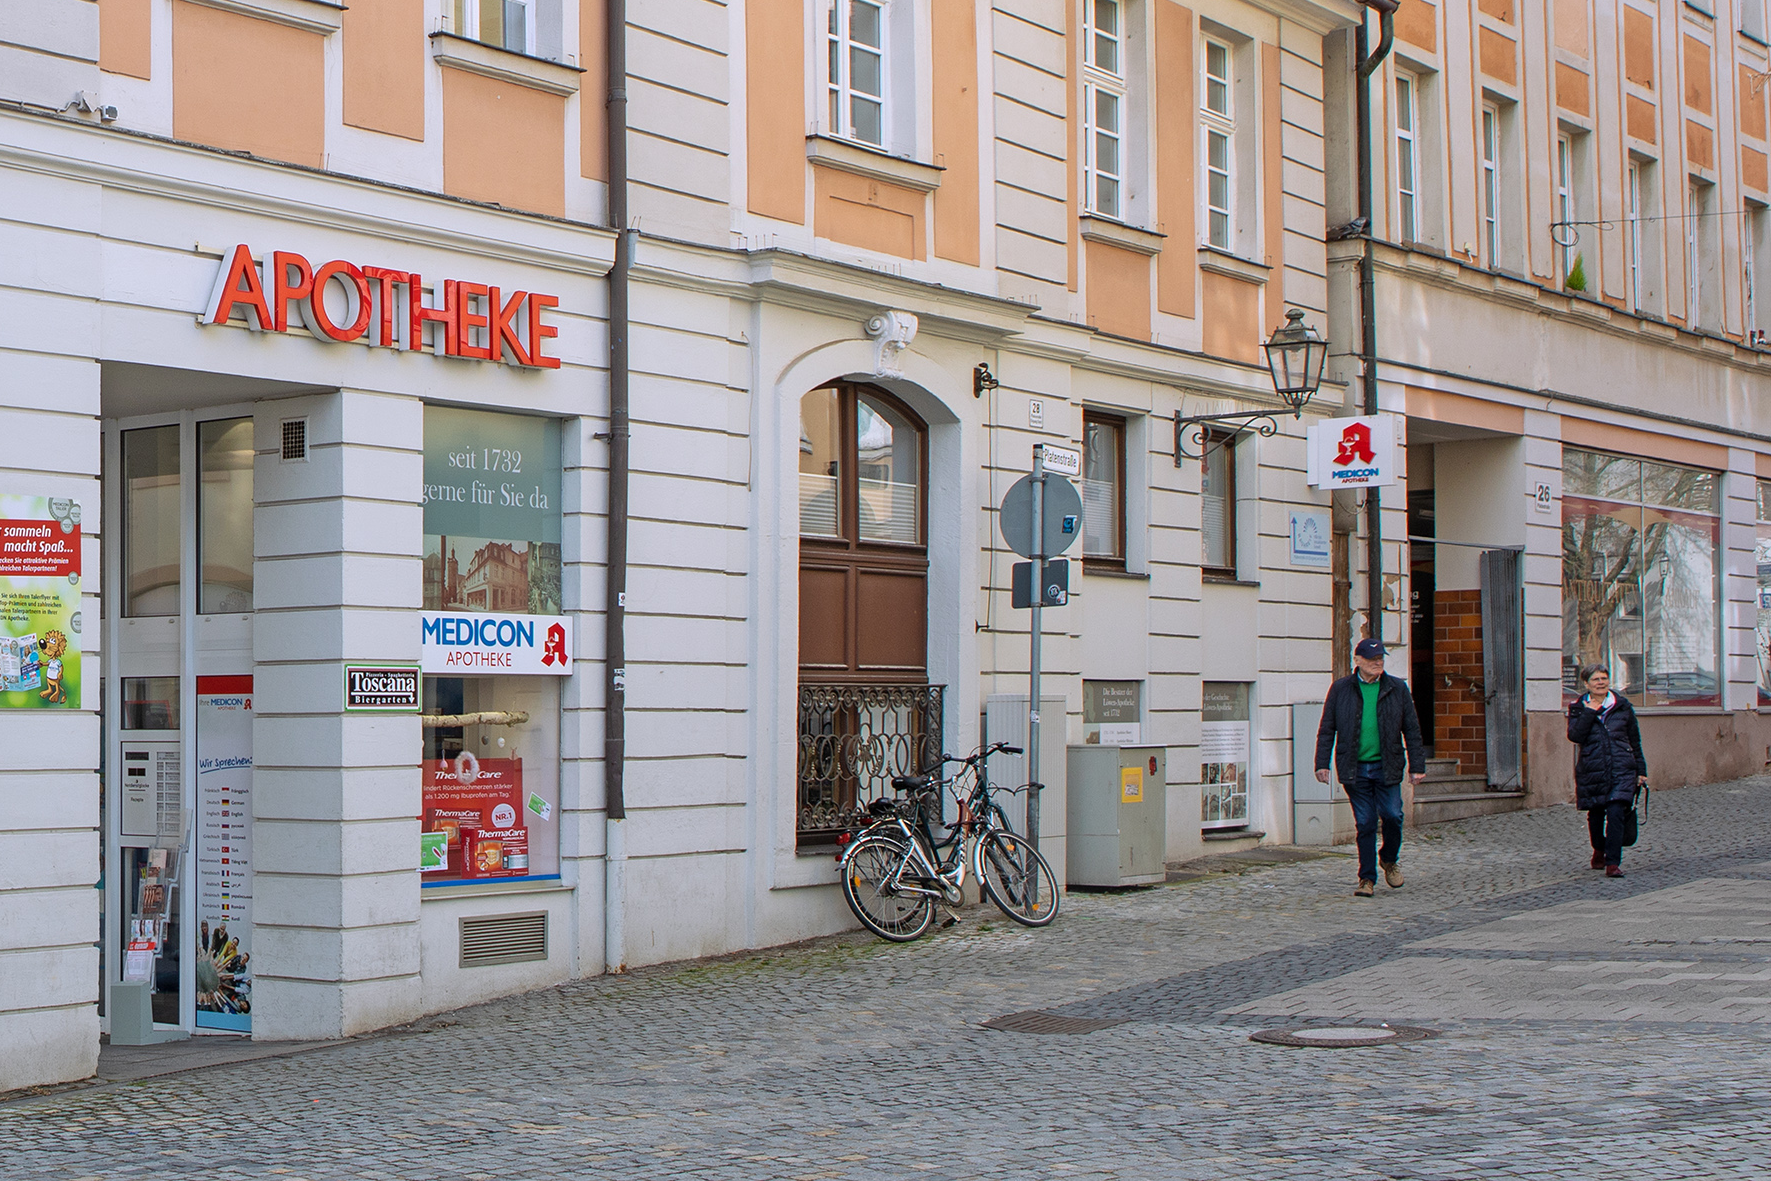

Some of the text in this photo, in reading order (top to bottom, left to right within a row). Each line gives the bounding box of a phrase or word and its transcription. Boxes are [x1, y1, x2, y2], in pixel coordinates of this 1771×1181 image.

[205, 243, 561, 370] APOTHEKE
[1032, 402, 1040, 413] 28
[448, 445, 522, 474] seit 1732
[1044, 448, 1077, 468] Platenstraße
[1331, 467, 1379, 479] MEDICON
[423, 480, 549, 509] gerne für Sie da
[1538, 485, 1550, 502] 26
[4, 524, 52, 538] sammeln
[4, 539, 74, 556] macht Spaß...
[422, 617, 534, 647] MEDICON
[446, 651, 512, 667] APOTHEKE
[351, 672, 415, 692] Toscana
[210, 698, 243, 706] MEDICON
[355, 695, 407, 705] Biergarten
[199, 758, 213, 768] Wir
[442, 783, 493, 791] Rückenschmerzen
[461, 791, 488, 799] Ibuprofen
[434, 808, 481, 817] ThermaCare
[477, 828, 526, 838] ThermaCare
